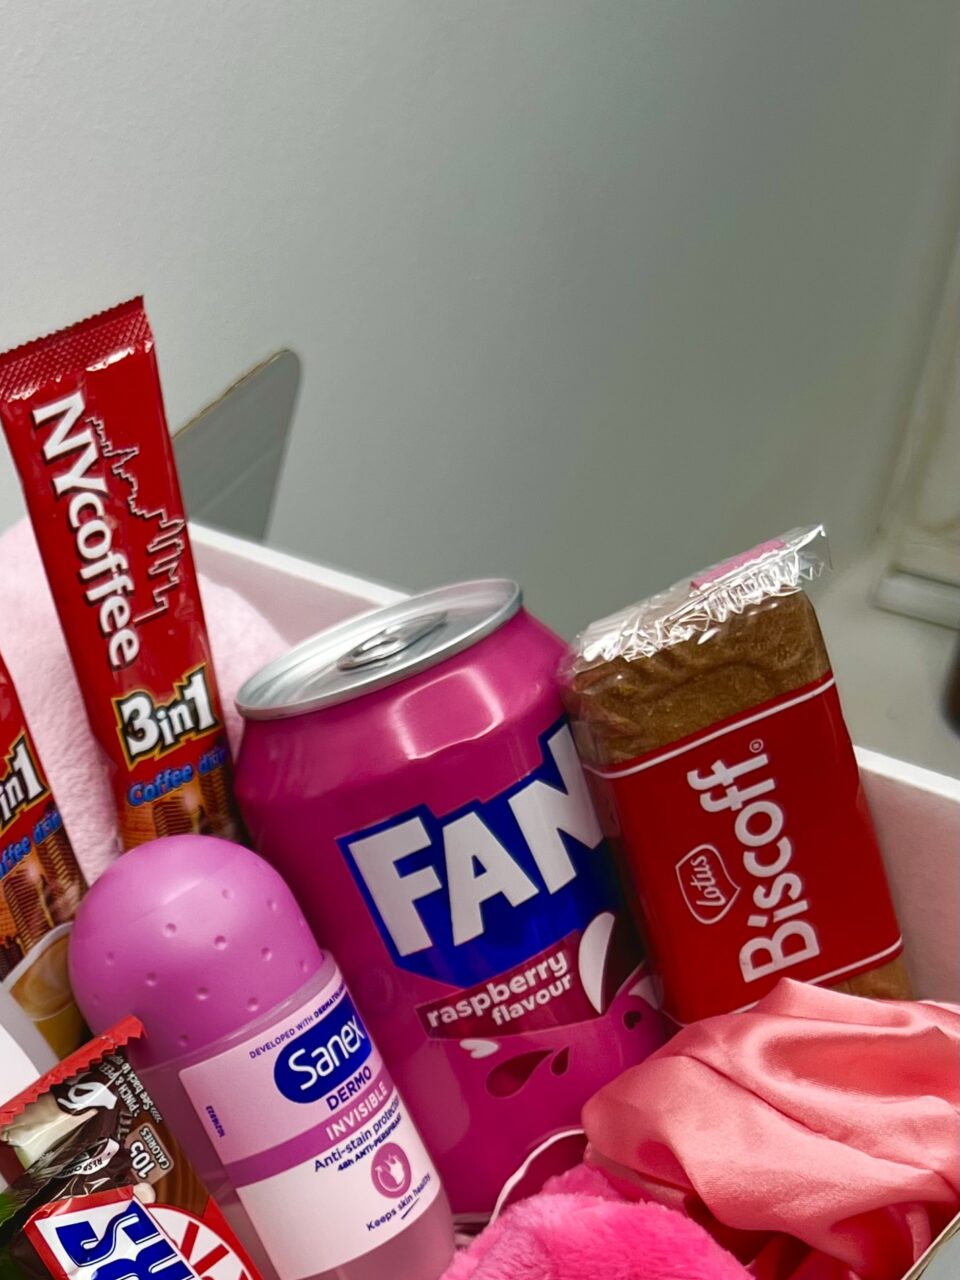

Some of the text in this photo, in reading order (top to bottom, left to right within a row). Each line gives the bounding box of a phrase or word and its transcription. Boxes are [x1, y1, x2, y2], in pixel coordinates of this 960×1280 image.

[121, 673, 216, 754] 3in1
[125, 762, 195, 807] Coffee
[688, 750, 820, 983] Biscoff
[427, 951, 568, 1027] raspberry
[492, 974, 573, 1026] flavour
[250, 1028, 295, 1059] DEVELOPED
[296, 1015, 314, 1032] WITH
[288, 1015, 365, 1090] Sanex
[118, 1084, 140, 1112] PINCH
[126, 1072, 143, 1092] back
[140, 1093, 152, 1110] See
[326, 1066, 372, 1111] DERMO
[326, 1081, 387, 1141] INVISIBLE
[129, 1141, 155, 1178] 105
[140, 1127, 170, 1170] CALORIES
[314, 1131, 372, 1172] Anti-stain
[367, 1207, 397, 1231] Keeps
[397, 1194, 414, 1212] skin
